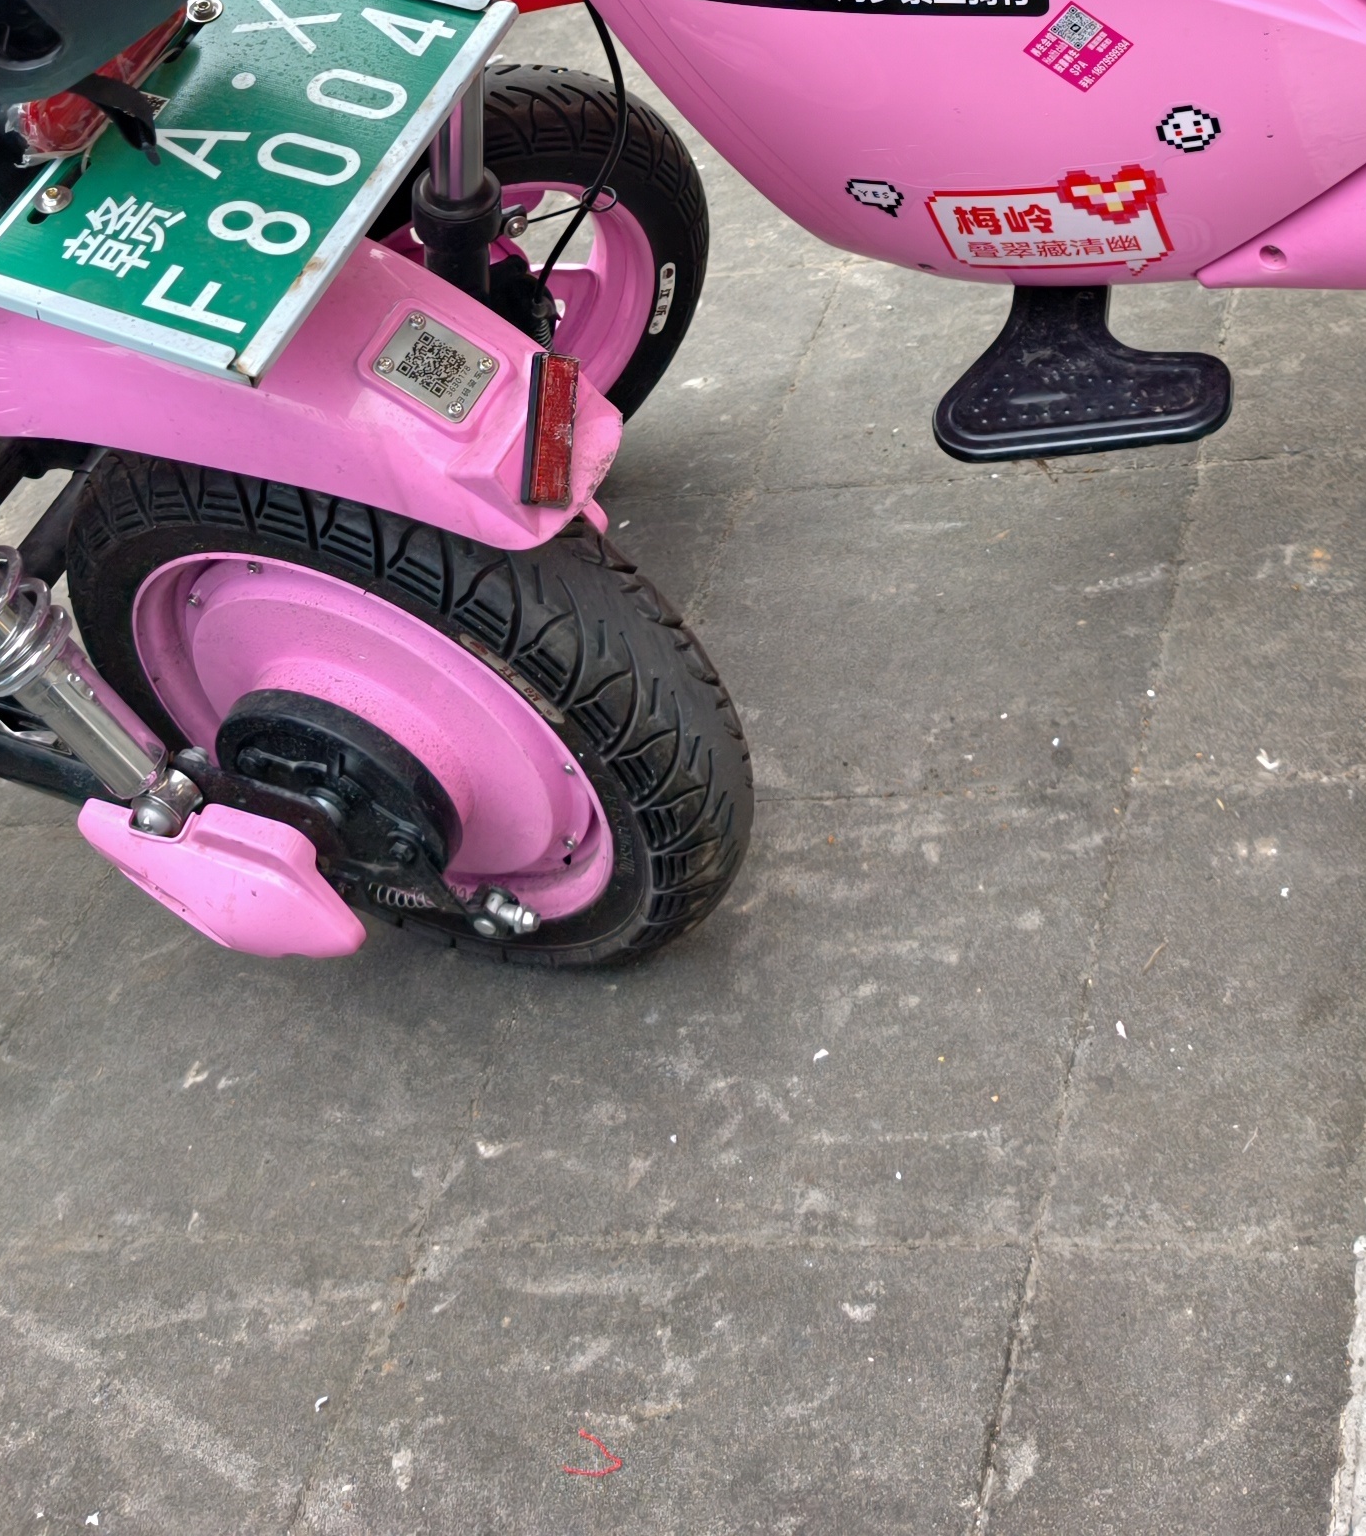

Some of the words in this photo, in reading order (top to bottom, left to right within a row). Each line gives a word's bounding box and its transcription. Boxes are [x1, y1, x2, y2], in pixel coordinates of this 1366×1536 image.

[1069, 60, 1088, 76] SPA
[142, 7, 457, 334] F8004
[858, 188, 890, 200] YES
[953, 204, 1054, 236] 梅岭
[446, 366, 471, 397] 3630178
